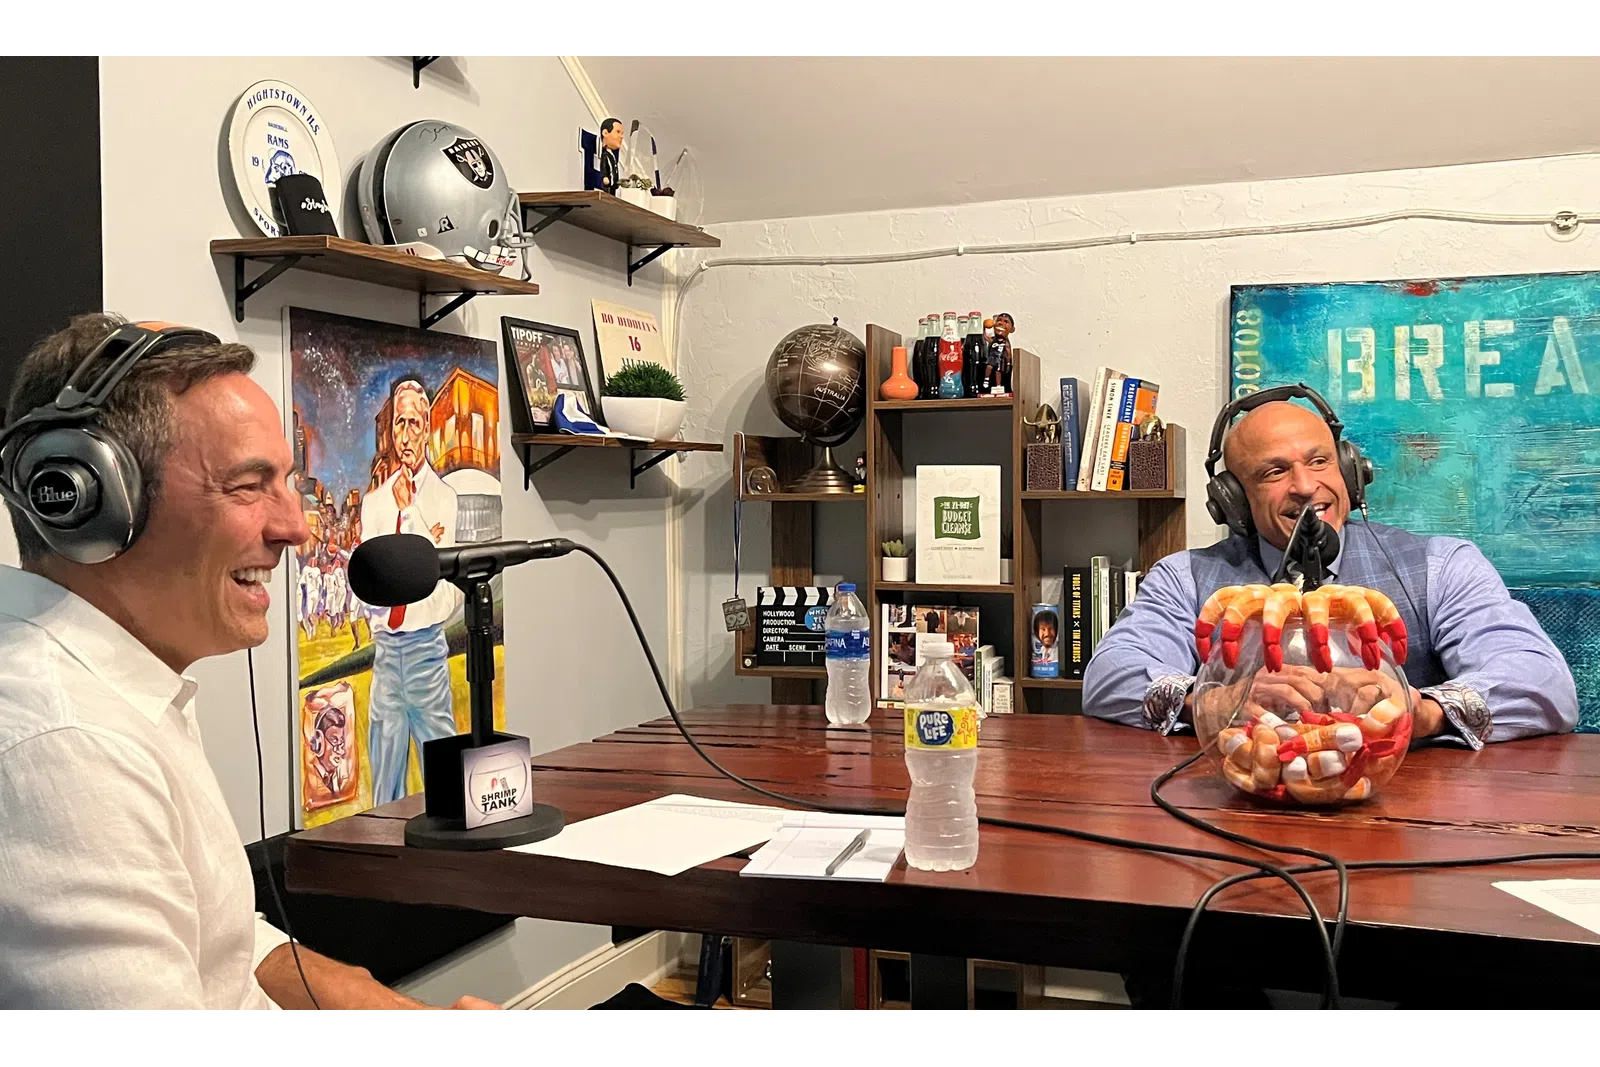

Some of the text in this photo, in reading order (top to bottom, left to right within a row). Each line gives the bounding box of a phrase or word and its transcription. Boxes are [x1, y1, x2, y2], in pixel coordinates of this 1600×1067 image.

[247, 88, 308, 116] HIGHTSTOWN
[267, 134, 289, 149] RAMS
[447, 139, 480, 155] RAIDERS
[601, 312, 614, 325] BO
[511, 326, 543, 344] TIPOFF
[628, 335, 642, 352] 16
[815, 386, 846, 401] AUSTRALIA
[37, 485, 76, 503] Blue
[942, 510, 972, 522] BUDGET
[1072, 573, 1081, 591] TOOLS
[1072, 600, 1081, 619] TITANS
[1072, 629, 1081, 640] TIM
[919, 712, 949, 729] PURE
[923, 726, 947, 740] LIFE
[481, 788, 517, 803] SHRIMP
[481, 796, 518, 812] TANK
